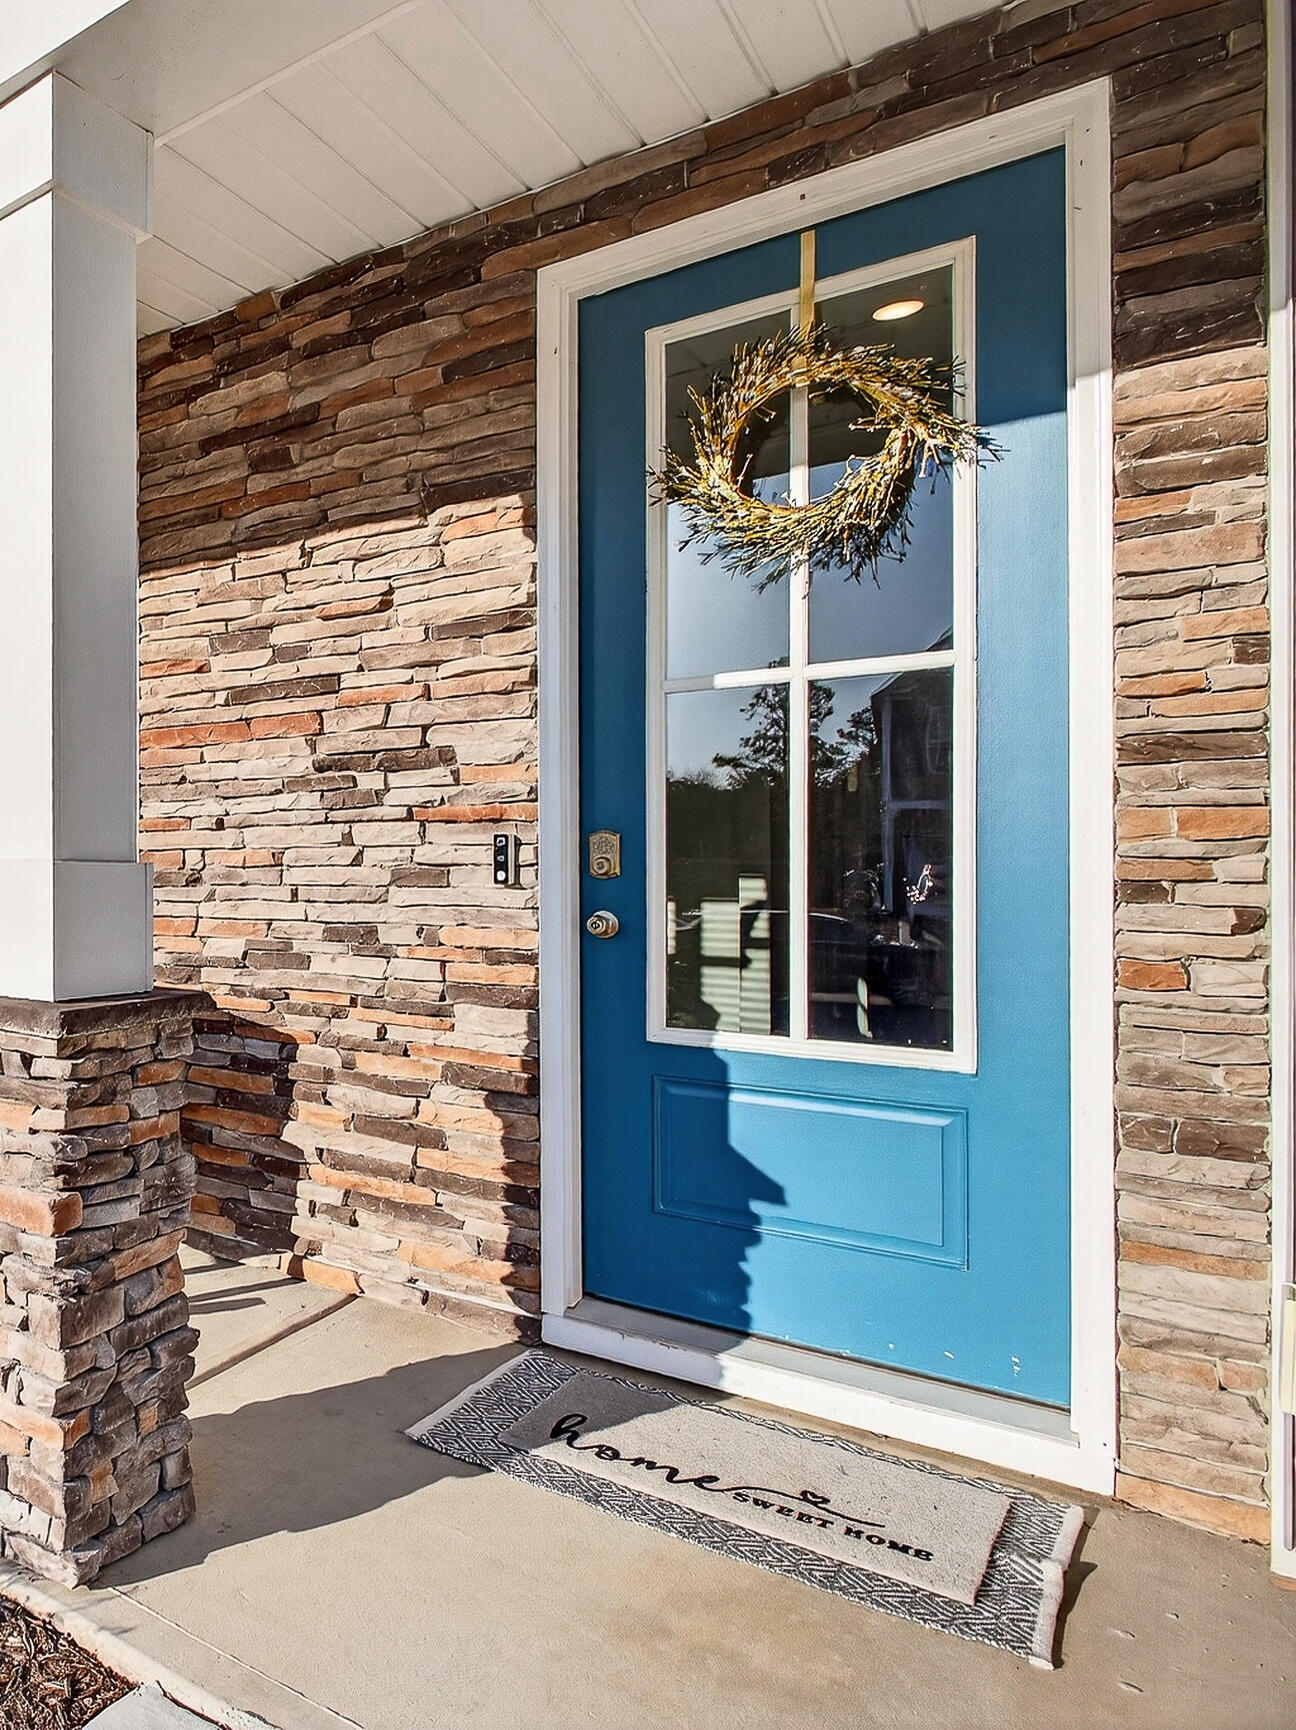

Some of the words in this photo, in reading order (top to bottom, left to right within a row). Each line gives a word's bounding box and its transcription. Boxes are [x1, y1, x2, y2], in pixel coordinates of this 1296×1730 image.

[549, 1413, 722, 1492] home
[732, 1491, 835, 1530] SWEET
[843, 1525, 935, 1562] HOME
